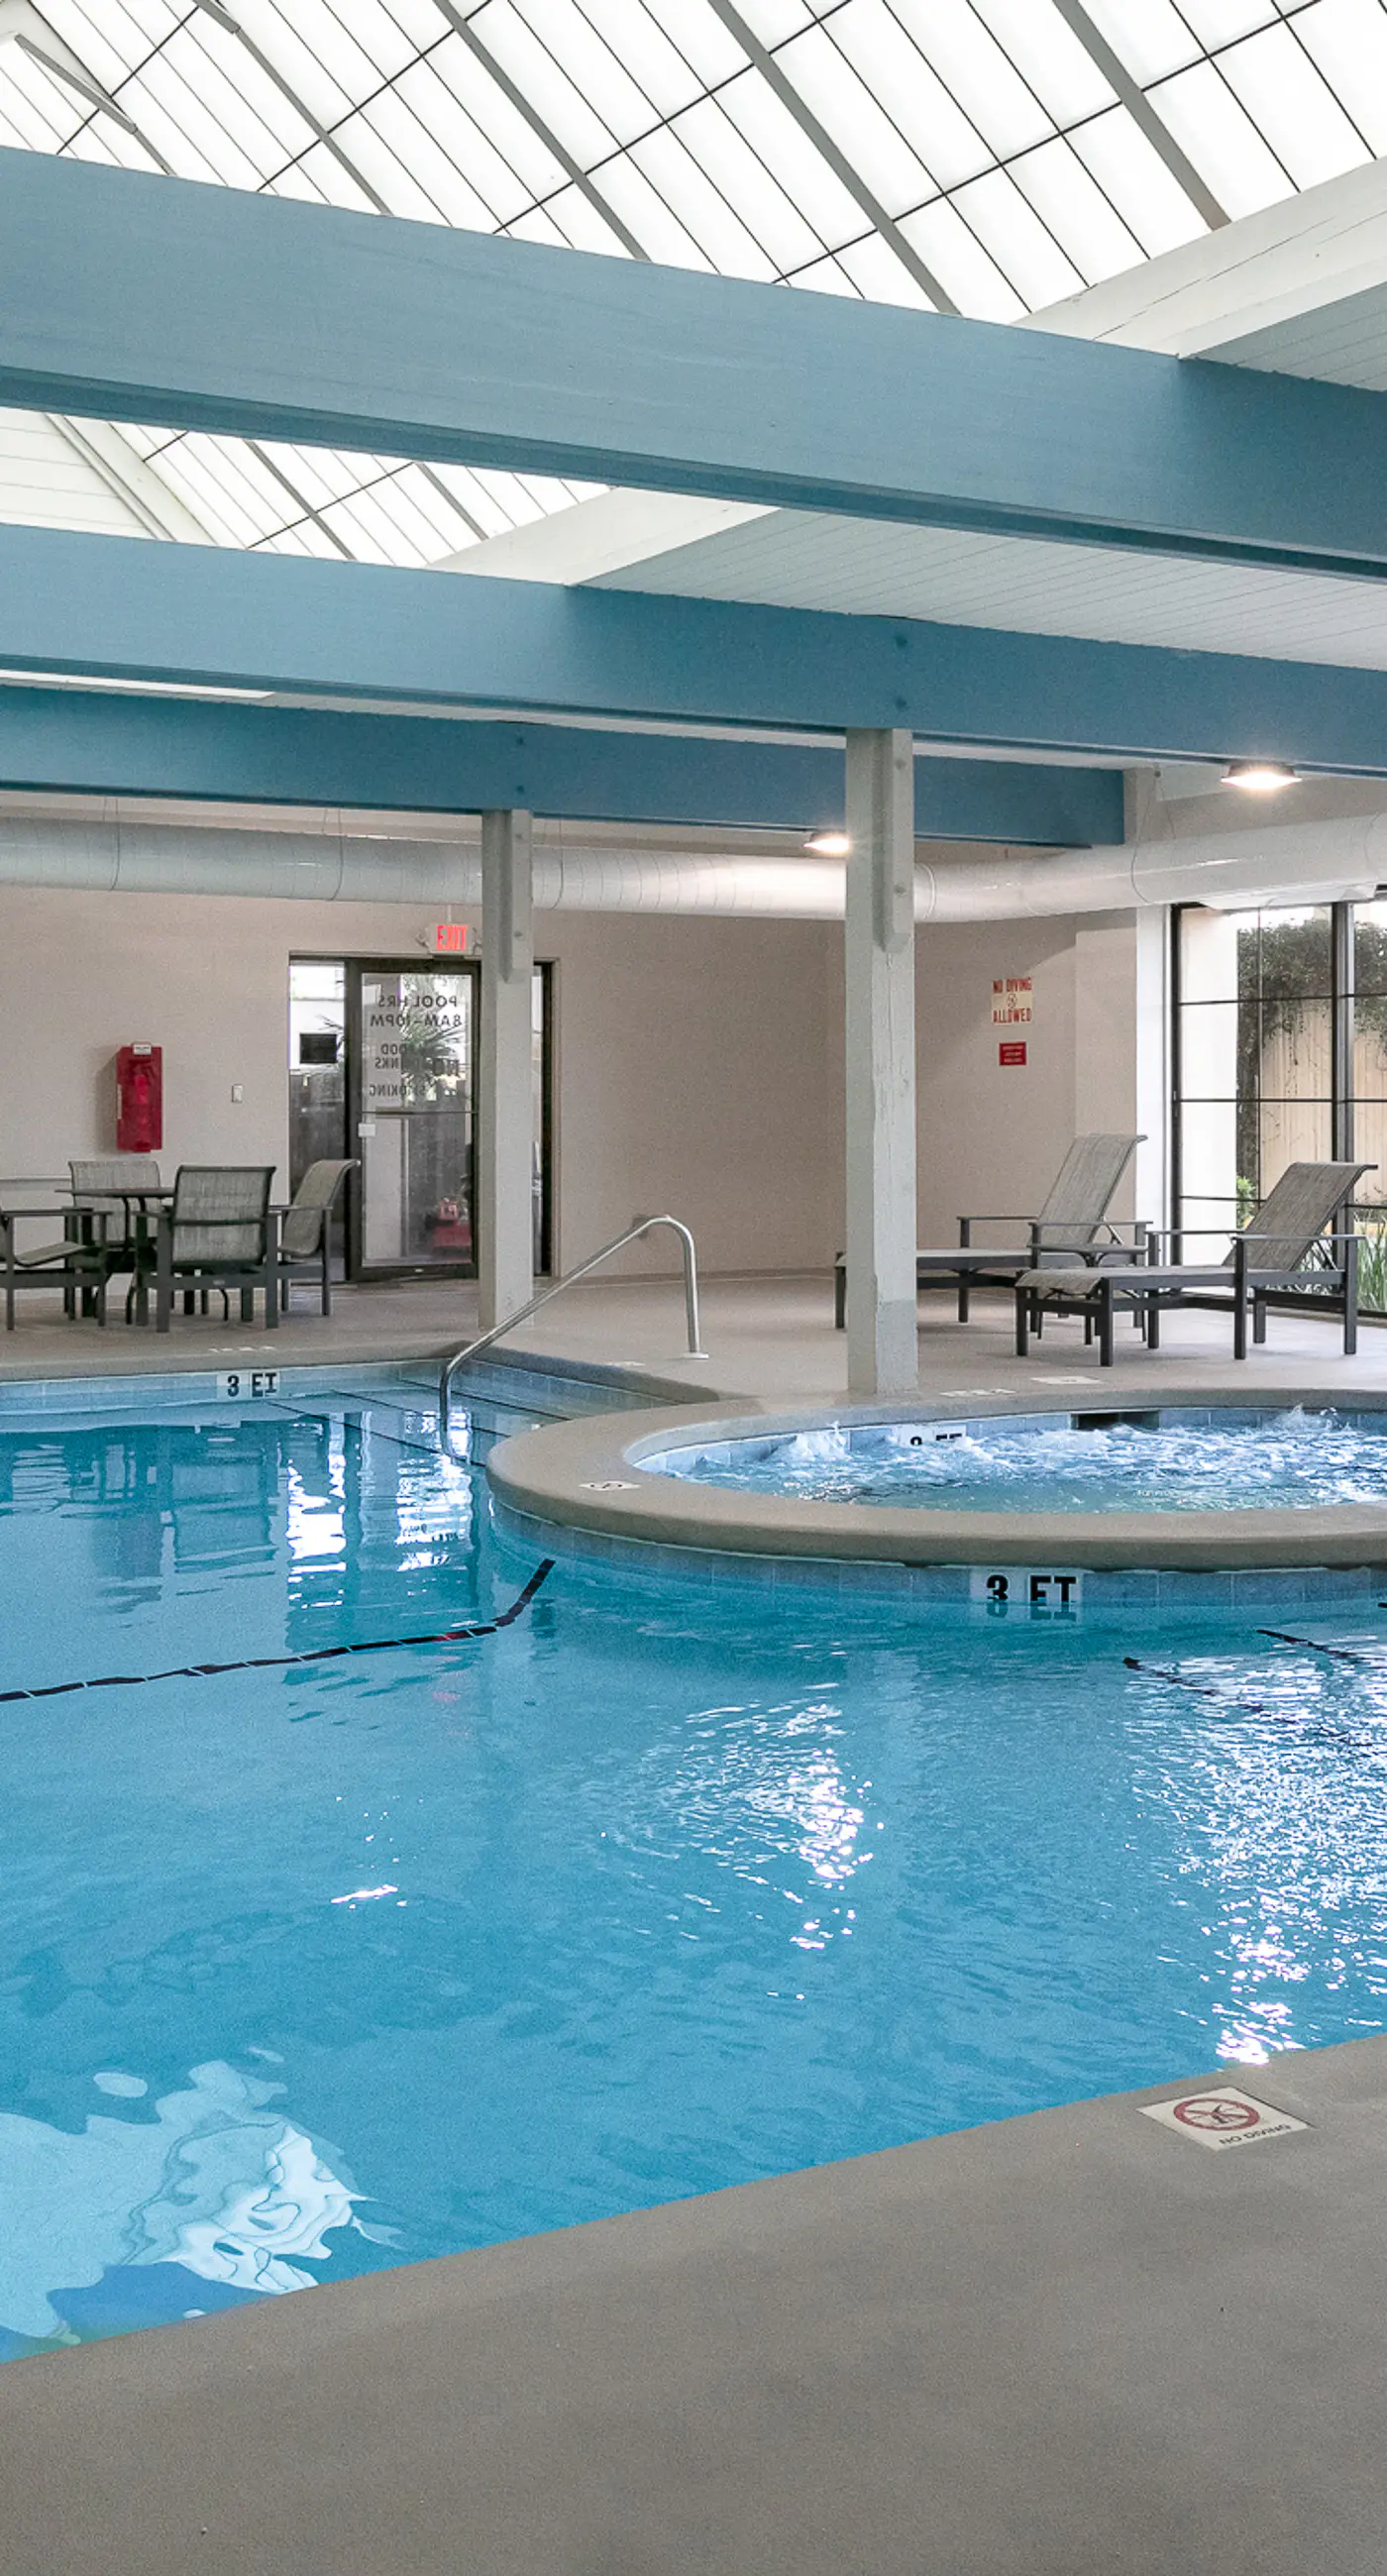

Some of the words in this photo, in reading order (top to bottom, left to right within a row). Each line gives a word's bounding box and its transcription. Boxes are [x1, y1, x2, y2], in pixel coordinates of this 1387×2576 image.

[437, 925, 468, 950] EXIT
[993, 980, 1003, 993] NO
[1007, 977, 1031, 992] DIVING
[994, 1008, 1031, 1023] ALLOWED
[228, 1374, 240, 1397] 3
[987, 1574, 1009, 1602] 3
[1030, 1575, 1077, 1604] FT
[1219, 2135, 1242, 2145] NO
[1242, 2123, 1292, 2139] DIVING
